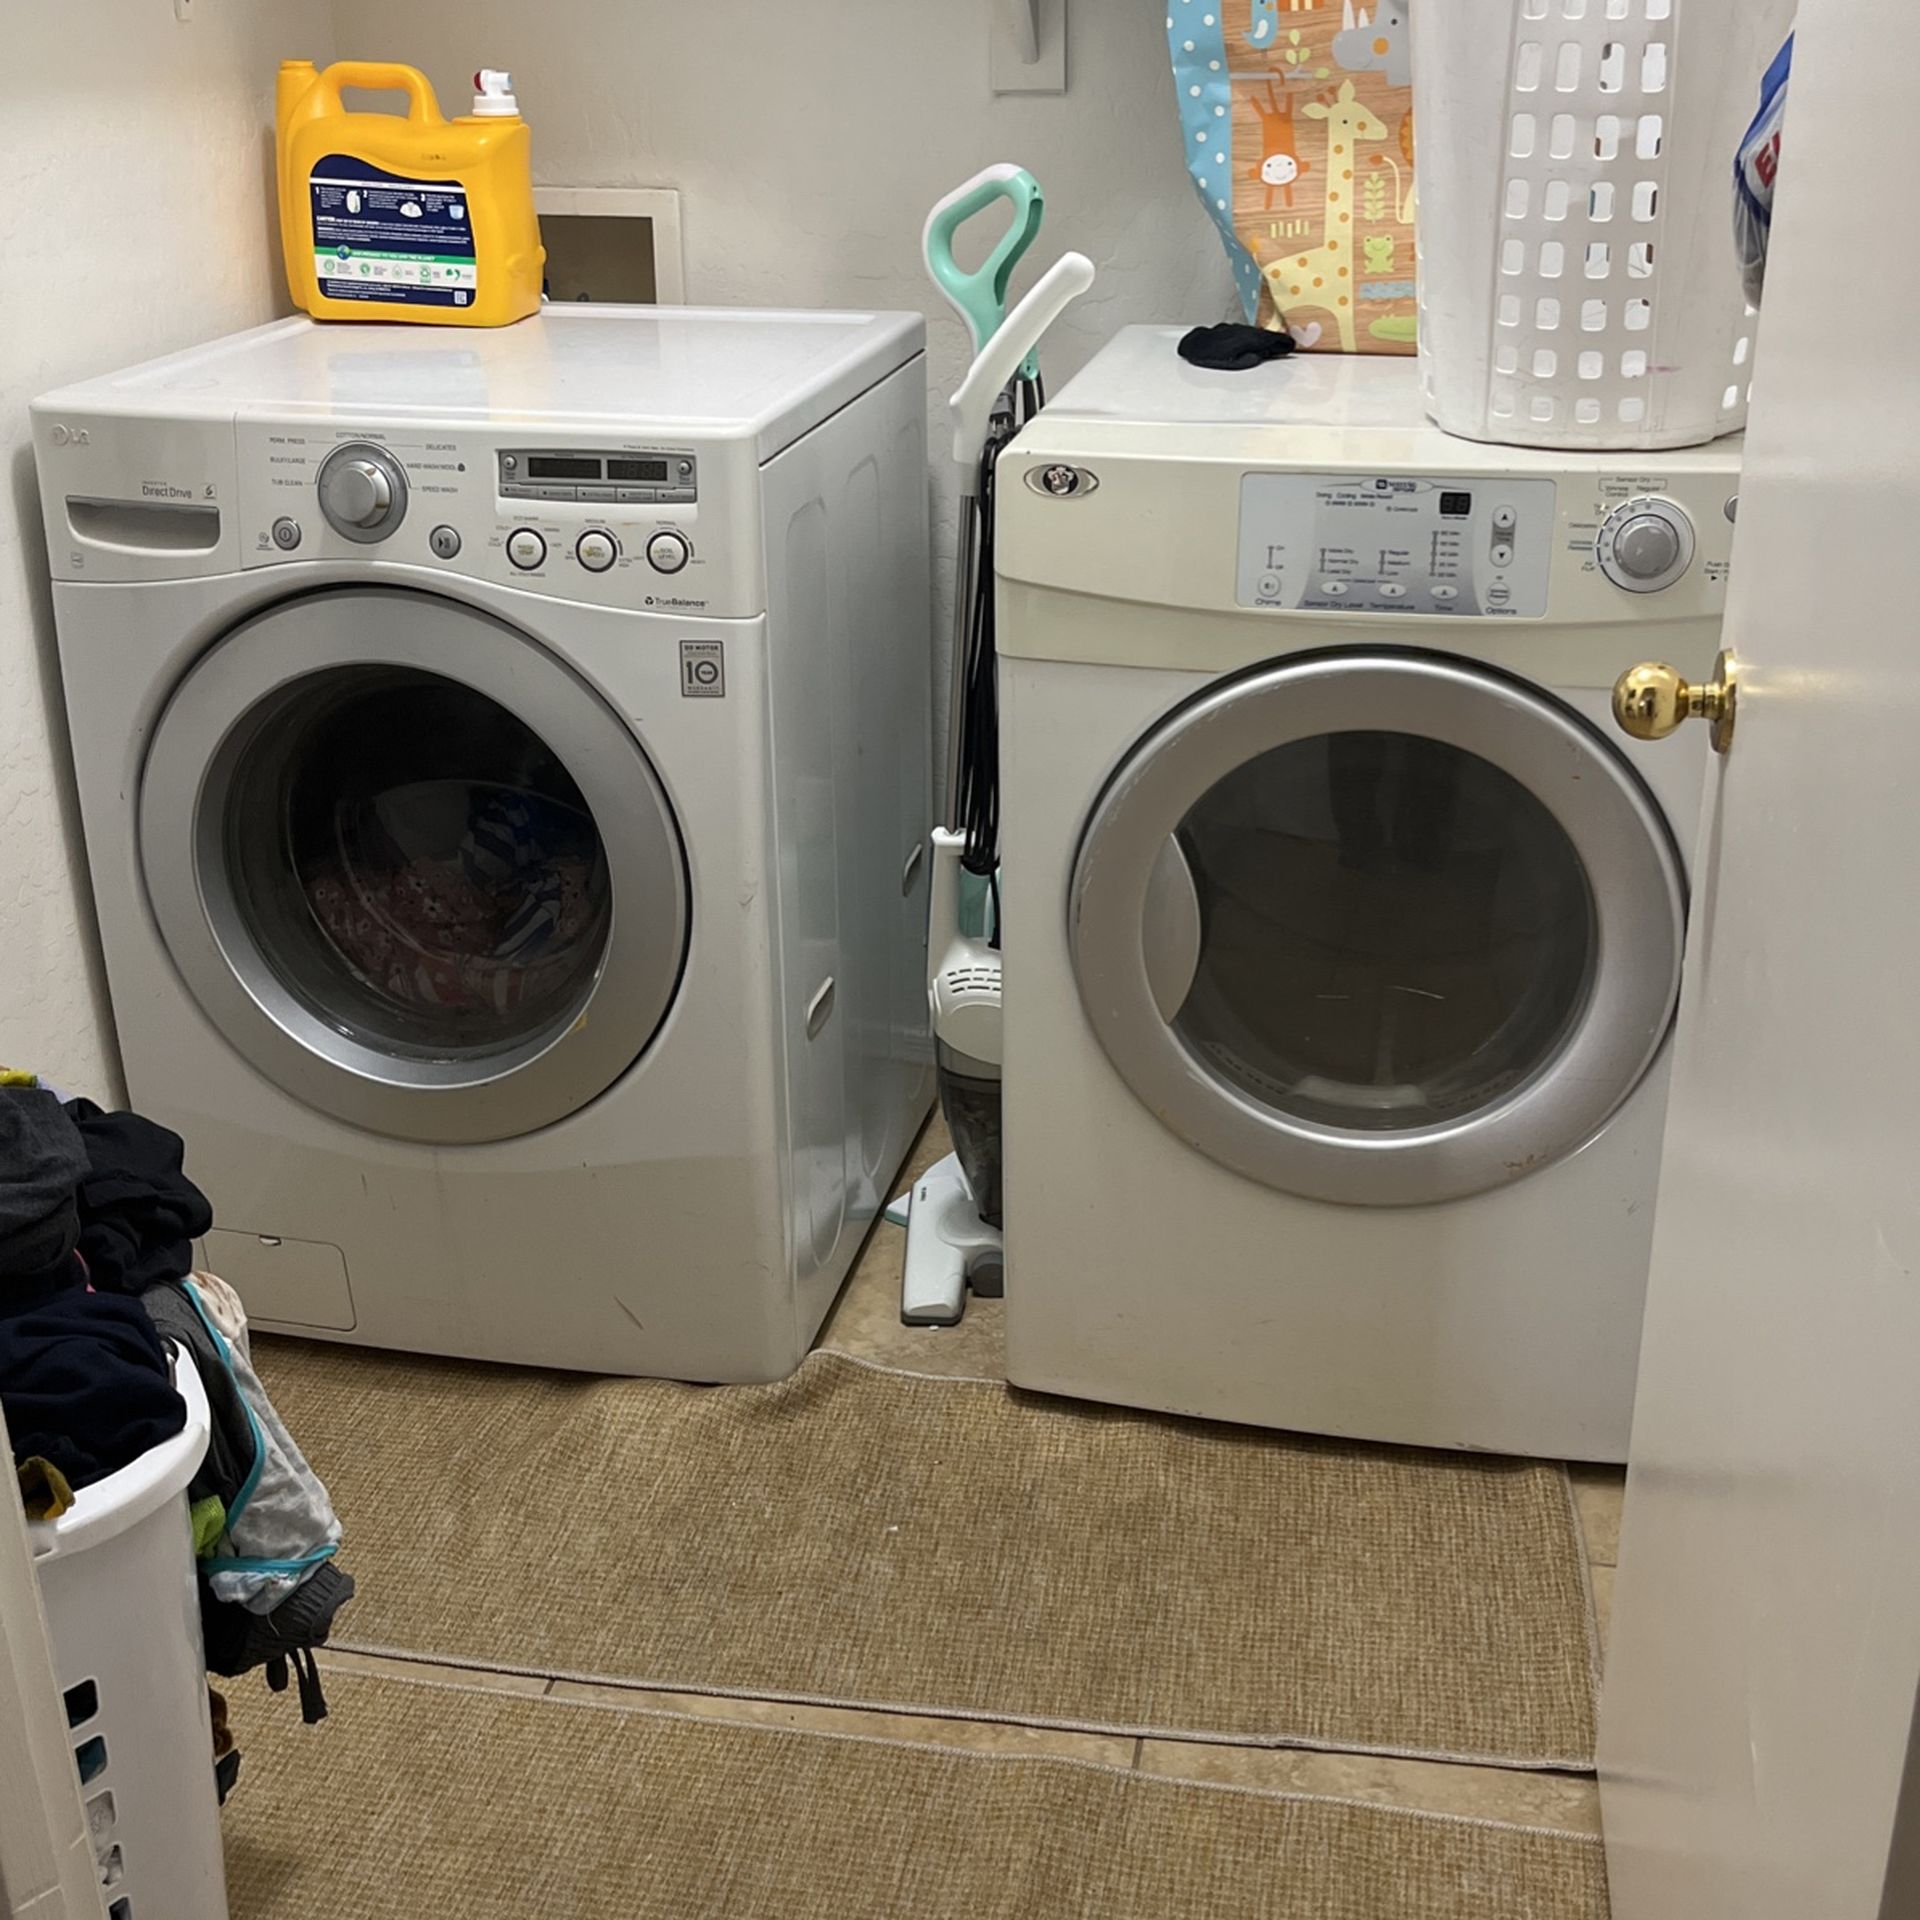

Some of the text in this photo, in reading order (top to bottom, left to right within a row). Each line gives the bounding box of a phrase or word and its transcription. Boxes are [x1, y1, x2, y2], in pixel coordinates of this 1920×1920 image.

[142, 485, 193, 499] Direct Drive
[1255, 598, 1282, 606] Chime
[1330, 601, 1342, 609] Dry
[1370, 602, 1416, 611] Temperature
[1485, 607, 1517, 615] Options
[686, 661, 719, 684] 10
